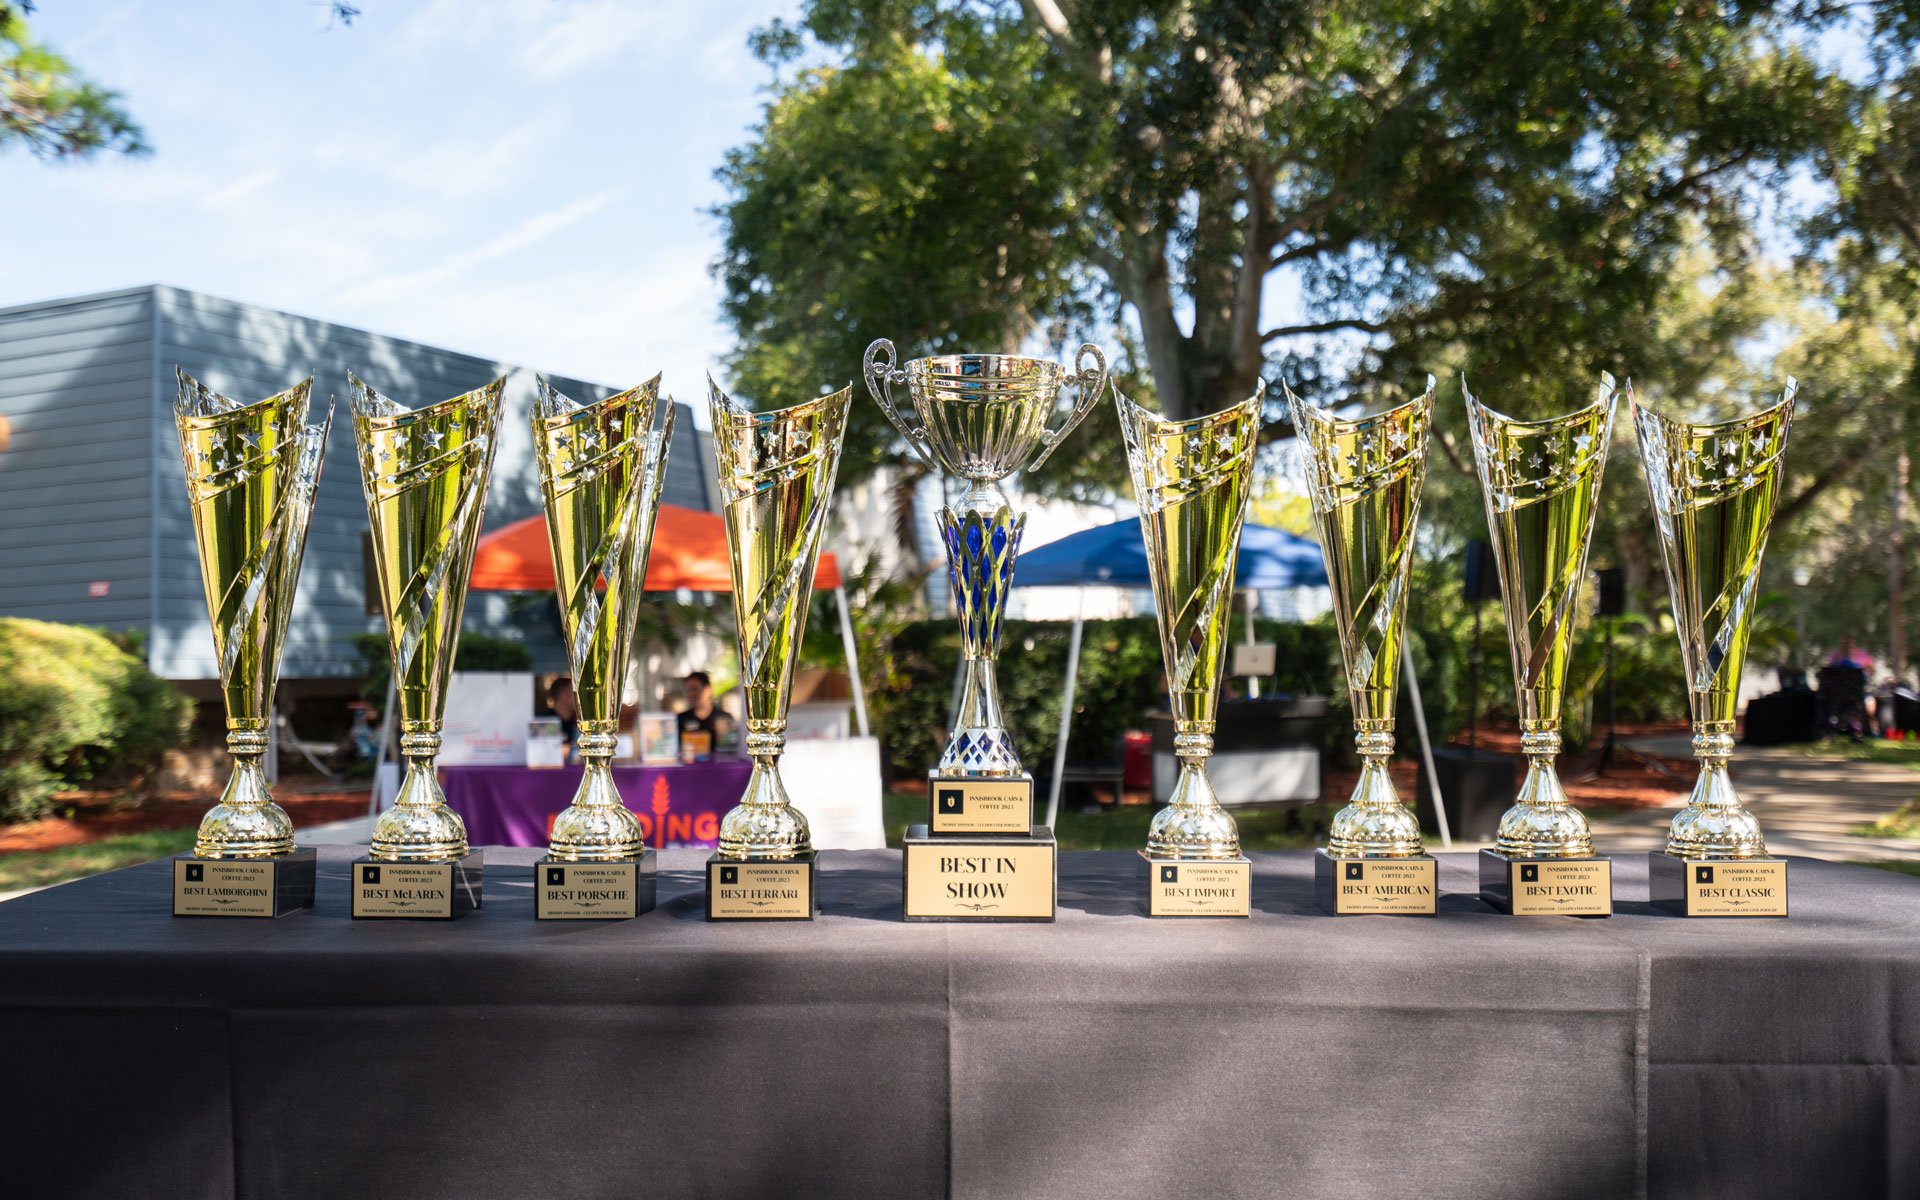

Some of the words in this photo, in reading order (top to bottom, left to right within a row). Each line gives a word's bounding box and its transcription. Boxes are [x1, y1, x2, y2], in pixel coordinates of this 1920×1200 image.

[940, 857, 991, 873] BEST
[997, 858, 1016, 873] IN
[208, 888, 267, 896] LAMBORGHINI
[363, 890, 391, 898] BEST
[394, 890, 444, 899] McLAREN
[721, 890, 749, 898] BEST
[751, 890, 797, 898] FERRARI
[947, 883, 1008, 899] SHOW
[1165, 888, 1192, 897] BEST
[1195, 888, 1237, 897] IMPORT
[1343, 886, 1370, 894] BEST
[1373, 886, 1430, 894] AMERICAN
[1527, 886, 1554, 895] BEST
[1557, 886, 1596, 895] EXOTIC
[1700, 889, 1728, 897] BEST
[1730, 889, 1775, 897] CLASSIC
[548, 891, 576, 900] BEST
[578, 891, 628, 900] PORSCHE
